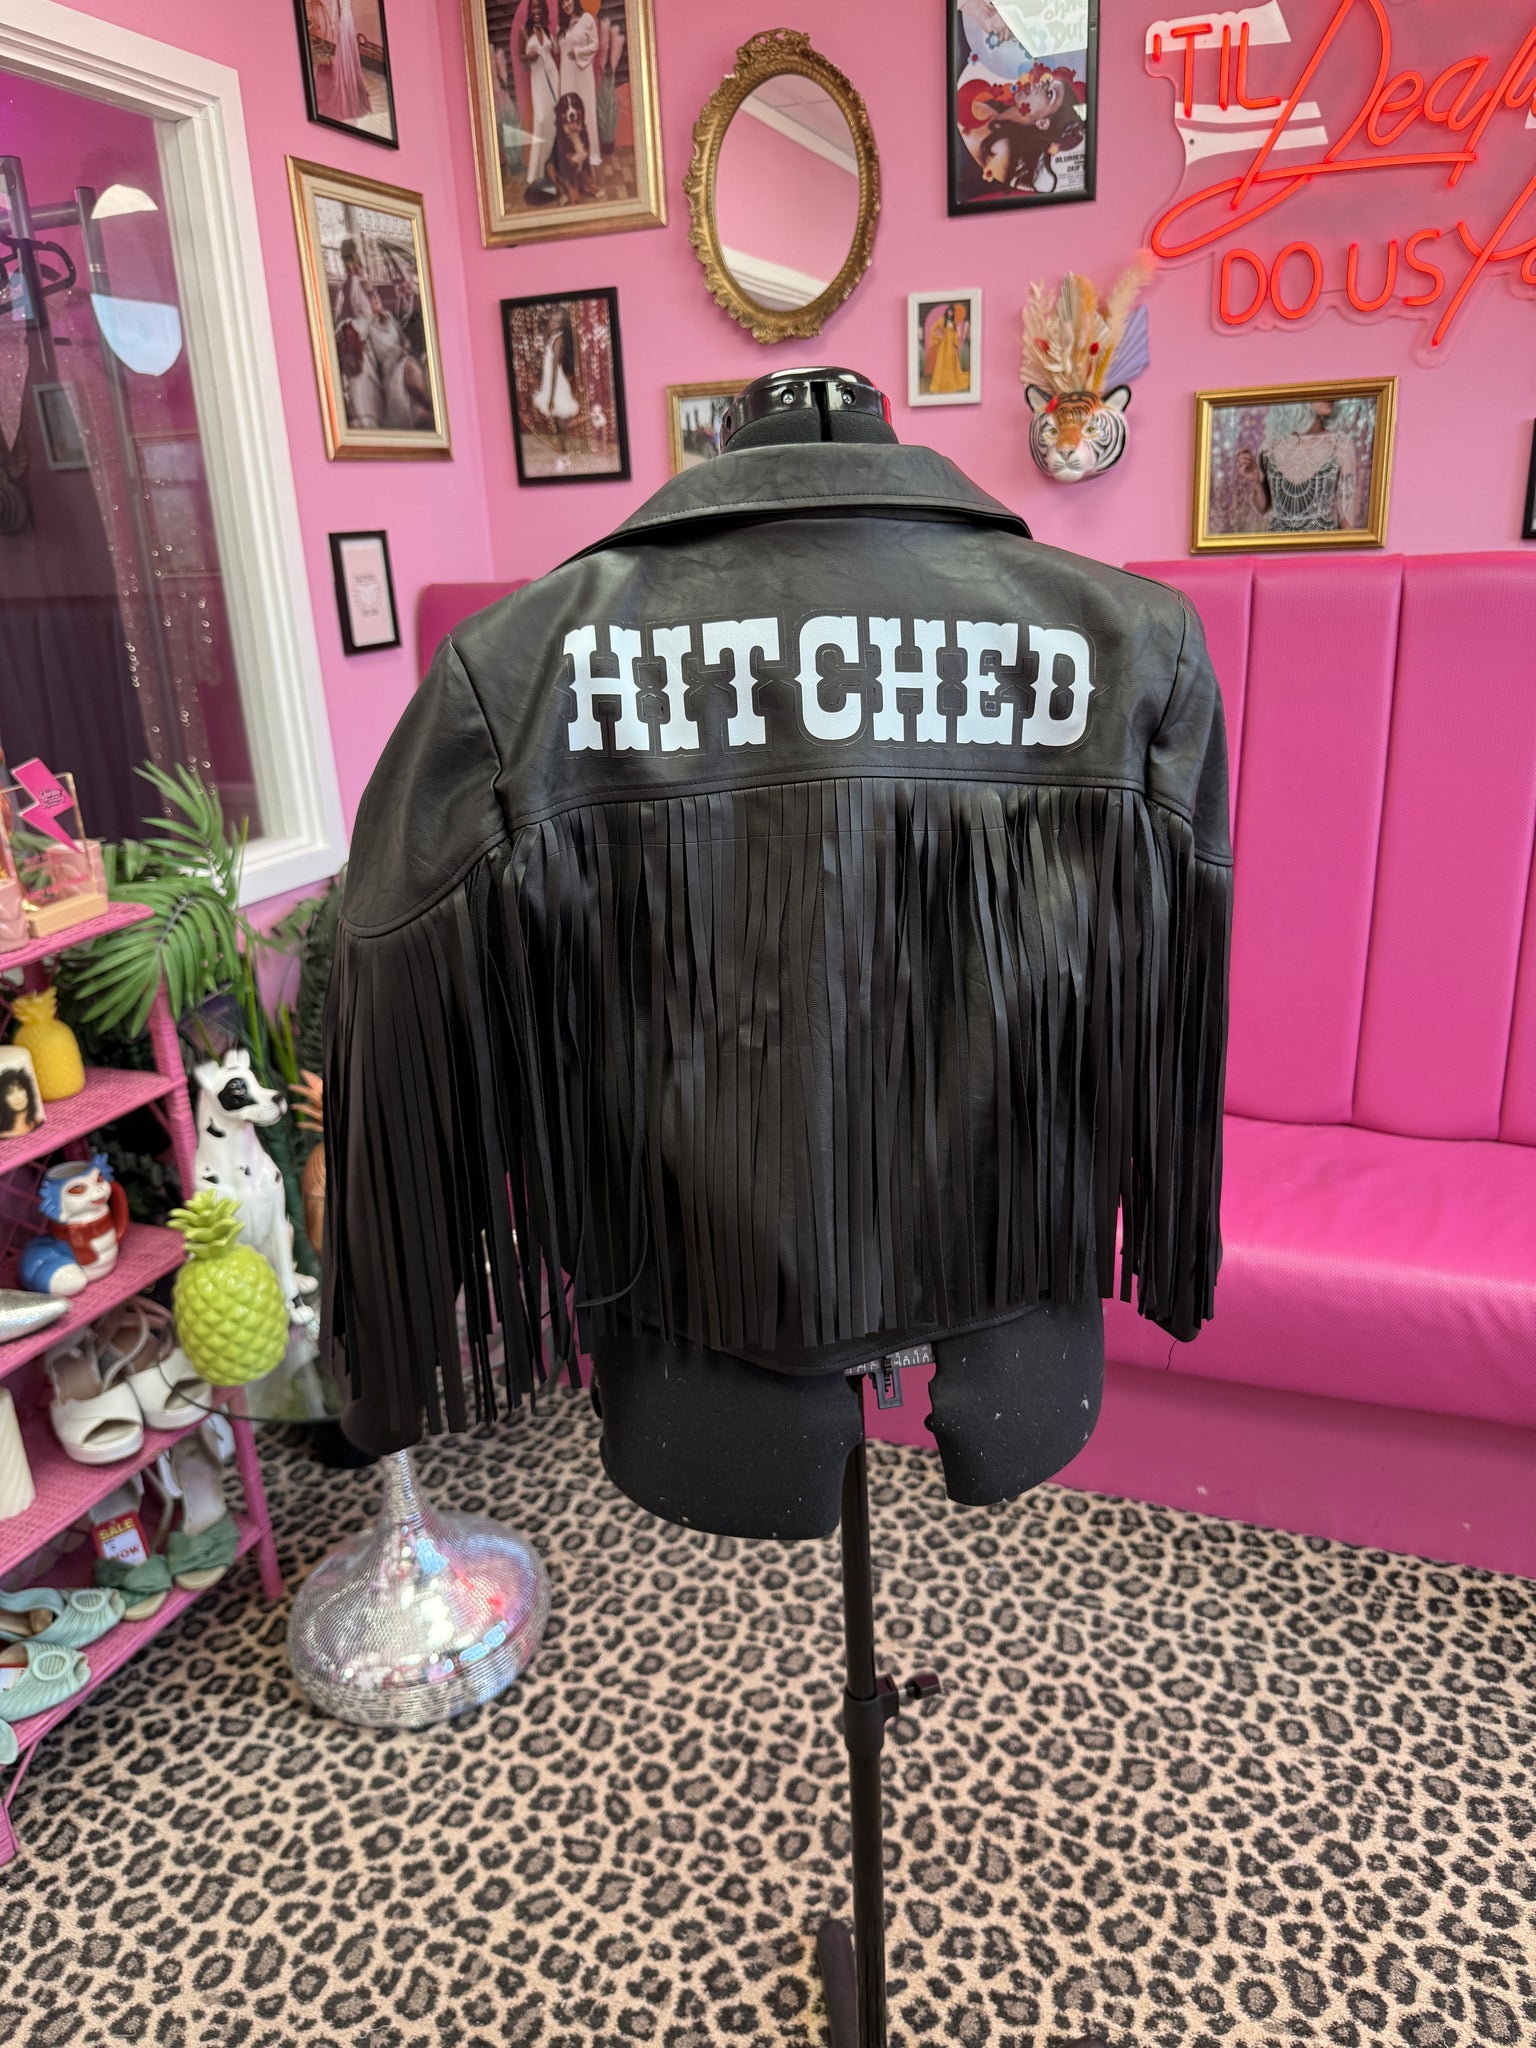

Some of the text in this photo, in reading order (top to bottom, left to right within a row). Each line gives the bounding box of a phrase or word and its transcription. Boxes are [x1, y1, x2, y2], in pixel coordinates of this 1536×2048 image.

[1219, 241, 1323, 325] DO
[1346, 229, 1445, 312] US
[563, 615, 1096, 752] HITCHED
[97, 1517, 135, 1541] SALE
